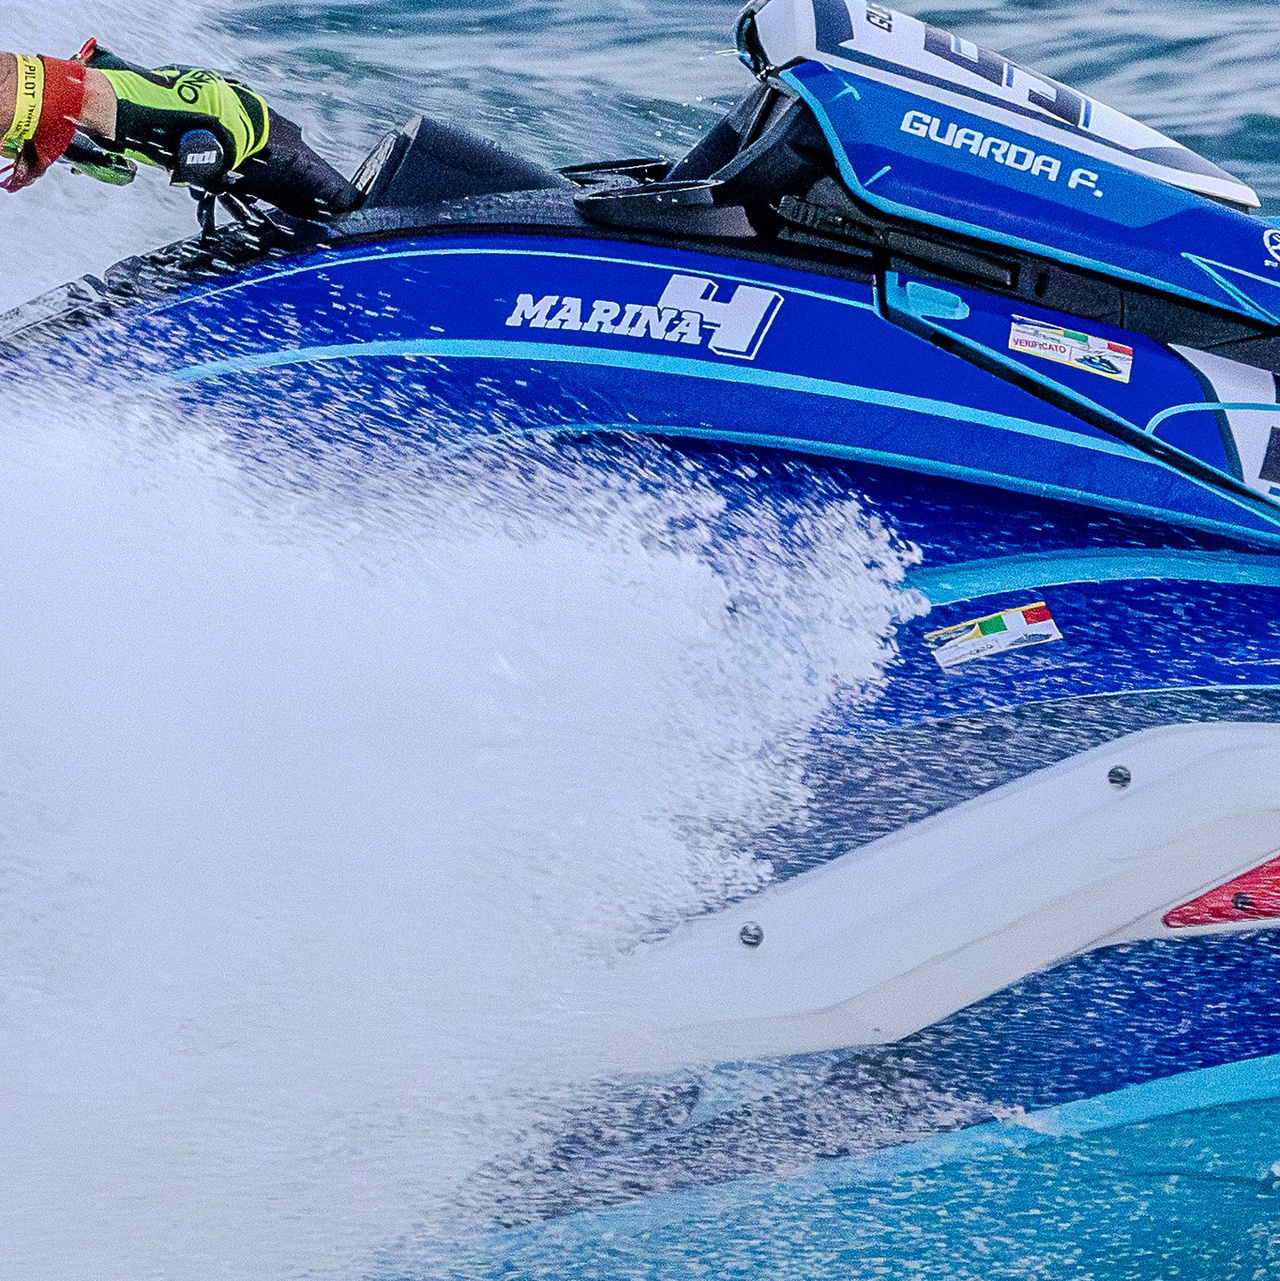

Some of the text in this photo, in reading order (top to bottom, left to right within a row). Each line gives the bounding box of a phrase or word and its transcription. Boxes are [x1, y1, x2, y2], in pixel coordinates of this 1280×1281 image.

[23, 64, 37, 99] PILOT
[899, 109, 1104, 198] GUARDA F.
[505, 293, 704, 345] MARINA
[1012, 338, 1067, 354] VERIFICATO
